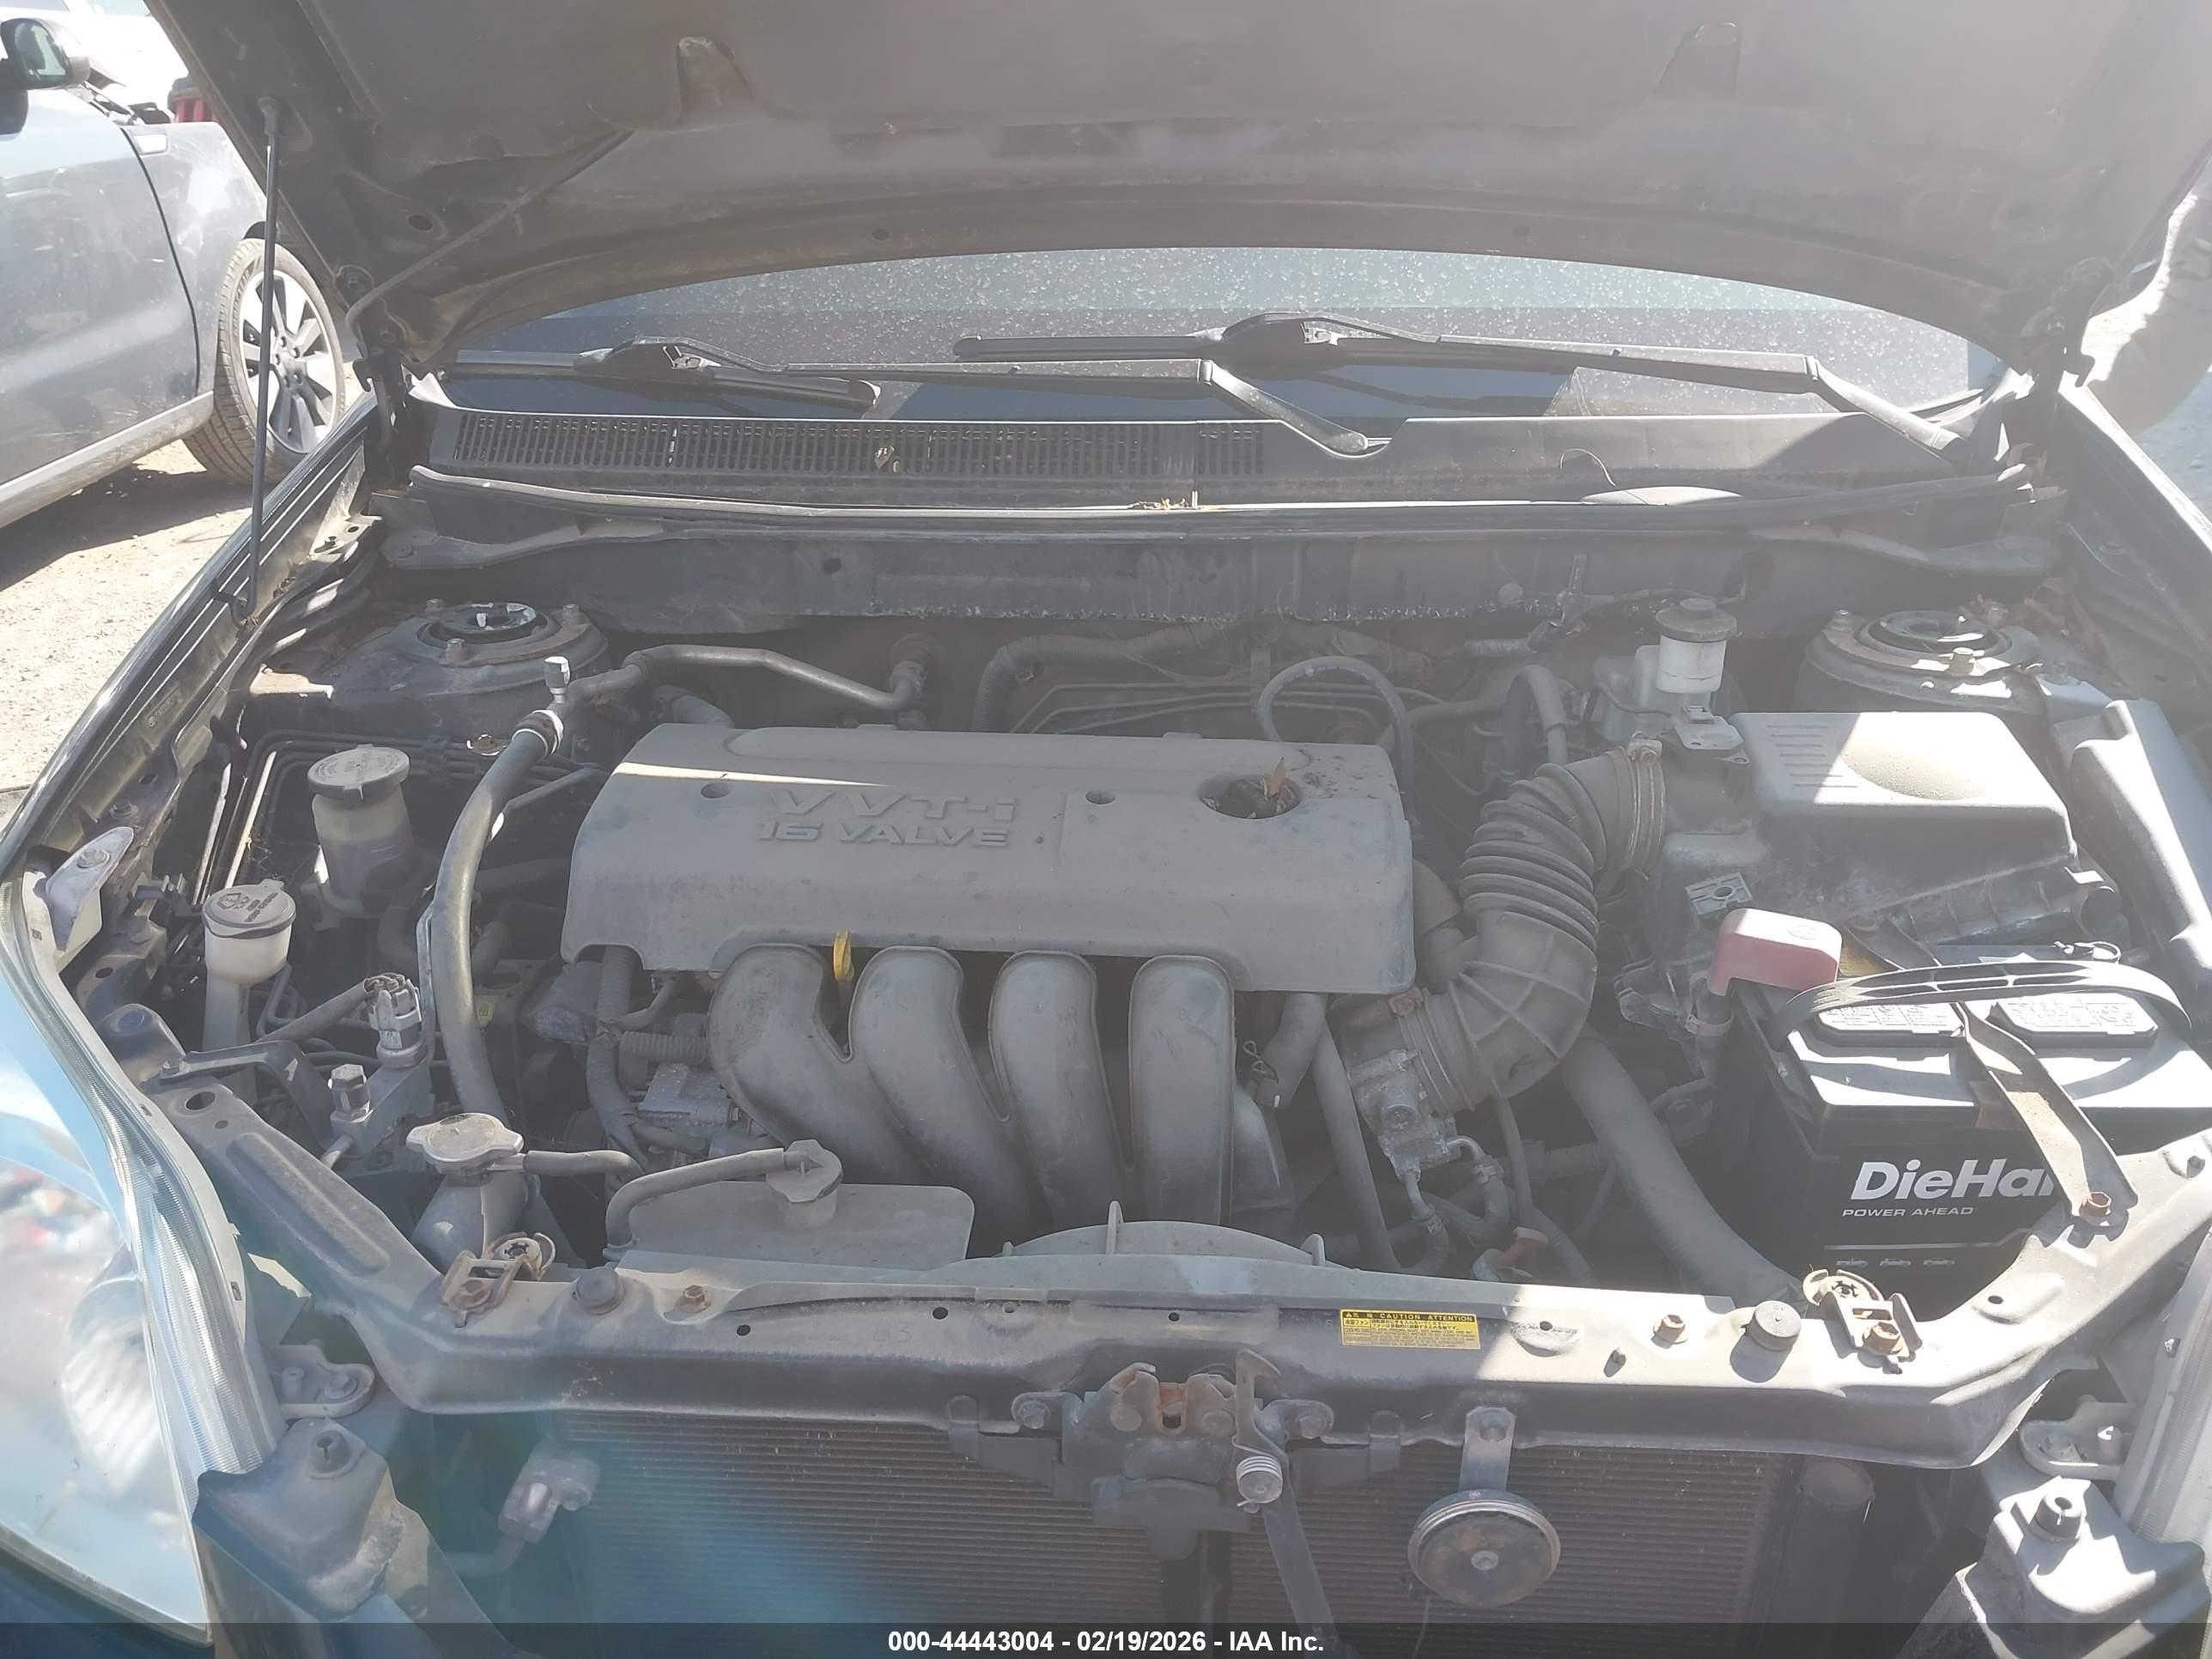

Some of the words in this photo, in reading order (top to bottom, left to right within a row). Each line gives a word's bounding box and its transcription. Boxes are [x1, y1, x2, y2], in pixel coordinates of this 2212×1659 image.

[759, 821, 822, 842] 16
[839, 823, 1010, 847] VALVE
[1842, 1207, 1905, 1217] POWER
[1911, 1206, 1974, 1216] AHEAD
